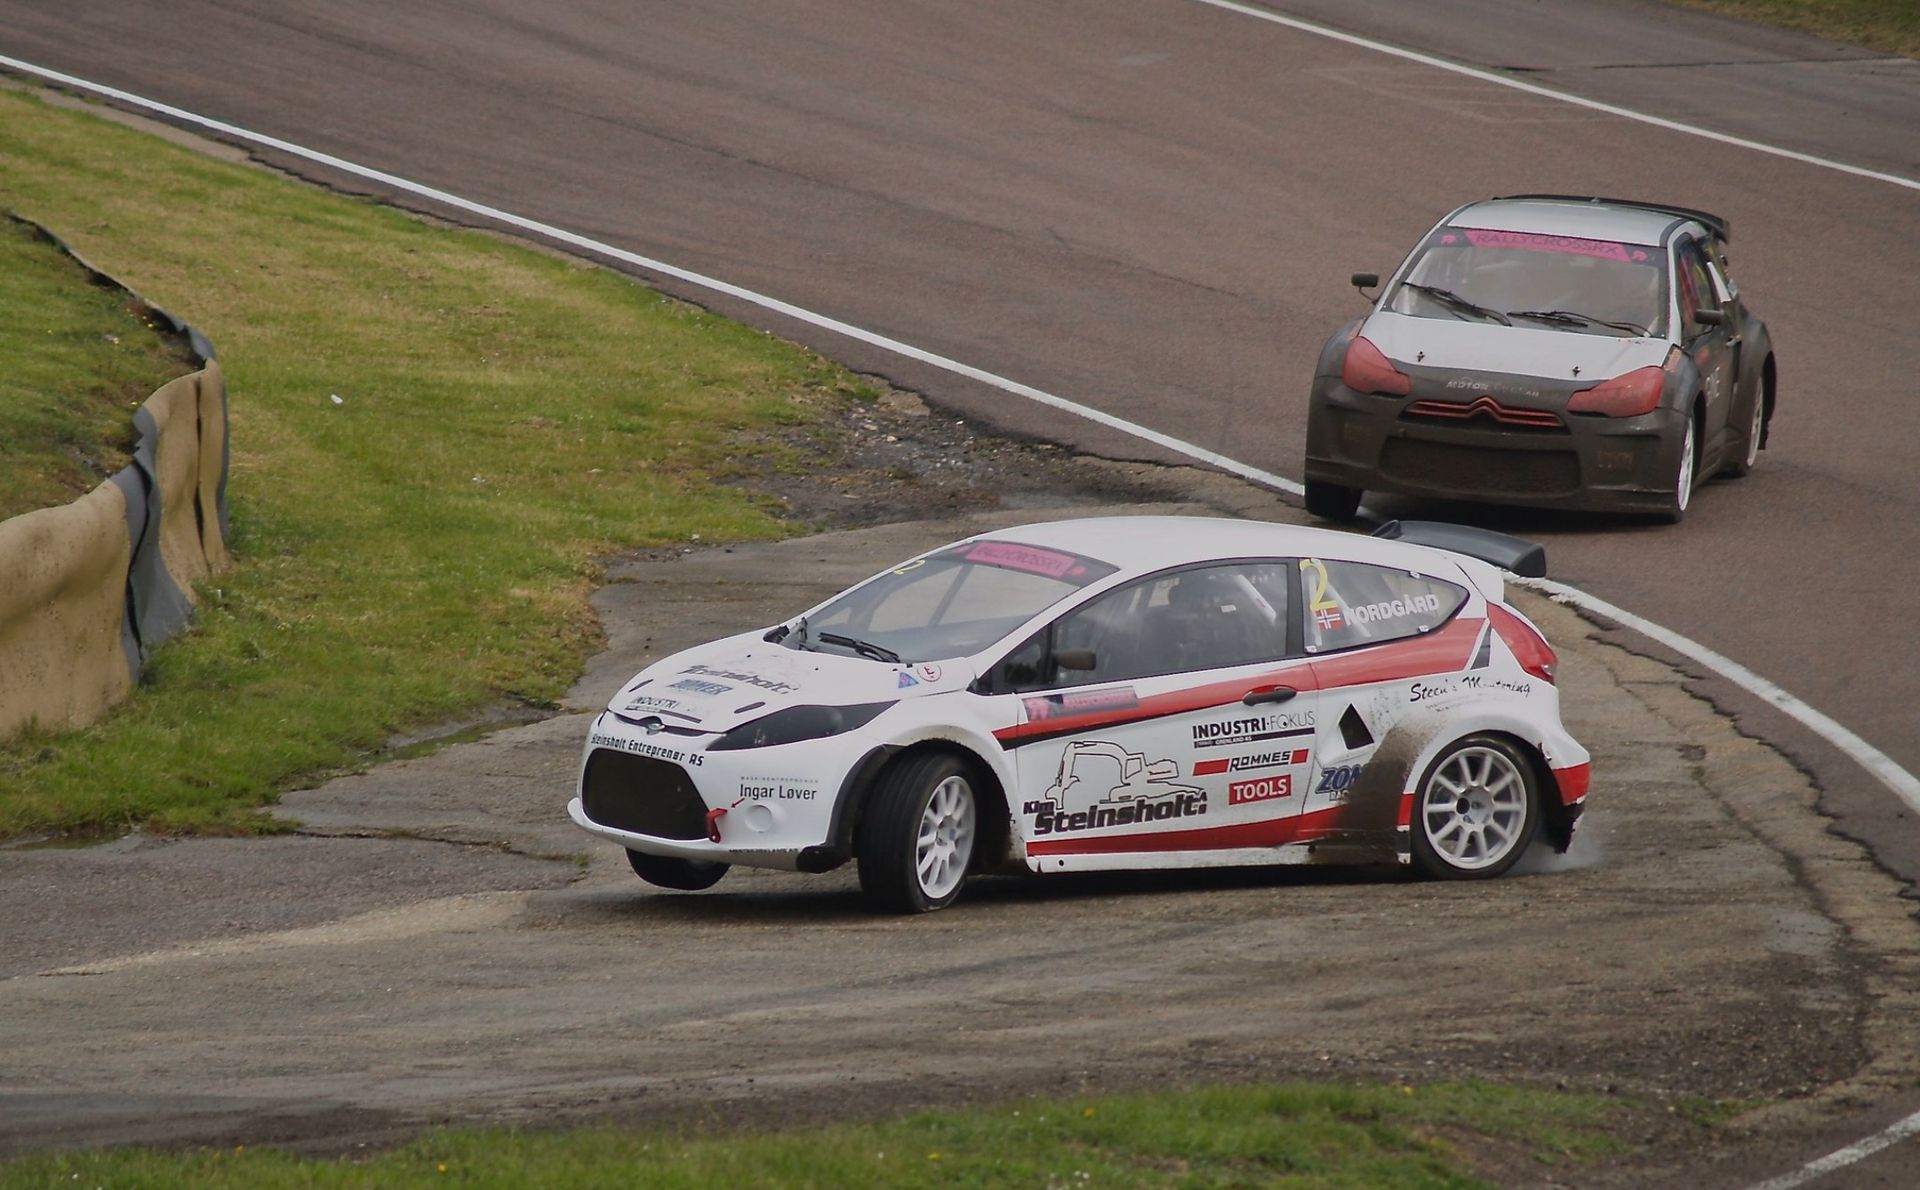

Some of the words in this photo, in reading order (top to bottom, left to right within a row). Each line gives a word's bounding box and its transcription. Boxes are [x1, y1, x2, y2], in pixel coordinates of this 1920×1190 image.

[1298, 558, 1339, 612] 2
[1342, 593, 1440, 626] NORDGÅRD
[688, 753, 705, 767] AS
[1229, 750, 1292, 773] ROMNES
[739, 783, 775, 801] Ingar
[1233, 778, 1288, 801] TOOLS
[1022, 800, 1056, 815] Kim
